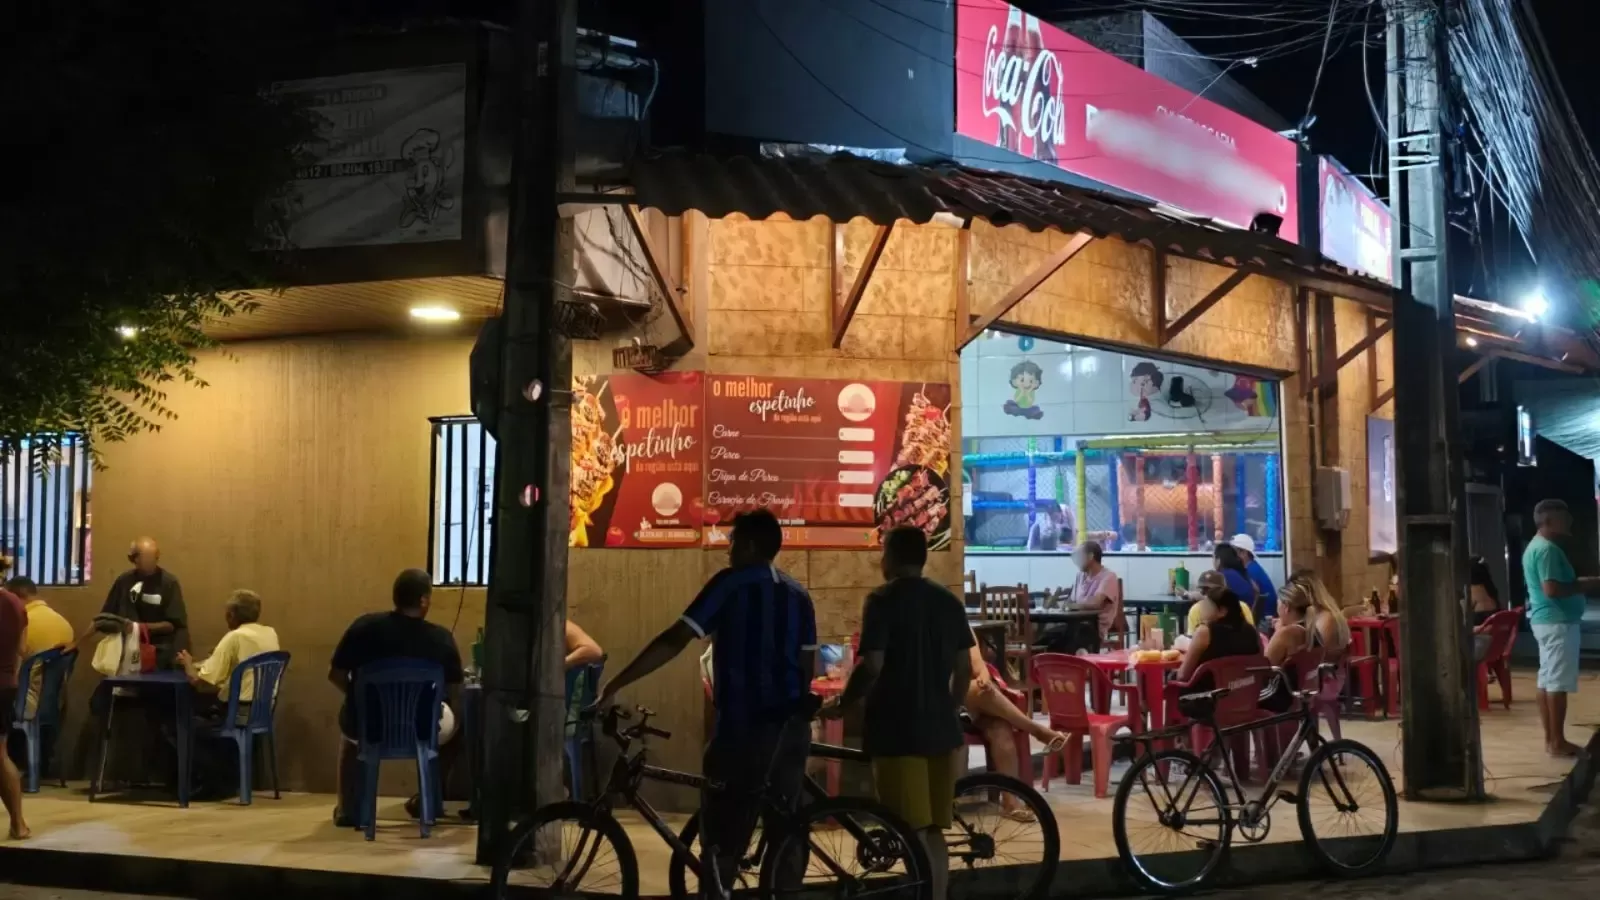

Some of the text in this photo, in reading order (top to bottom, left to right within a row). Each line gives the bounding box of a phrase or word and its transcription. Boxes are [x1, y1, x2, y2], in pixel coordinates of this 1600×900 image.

[983, 24, 1066, 145] Coca-Cola
[725, 377, 774, 398] melhor
[636, 398, 699, 430] melhor
[749, 387, 817, 422] espetinho
[712, 424, 741, 439] Carne
[610, 422, 698, 474] espetinho
[710, 446, 741, 460] Porco
[708, 468, 779, 485] Tripa de Porco
[758, 491, 796, 509] Frango
